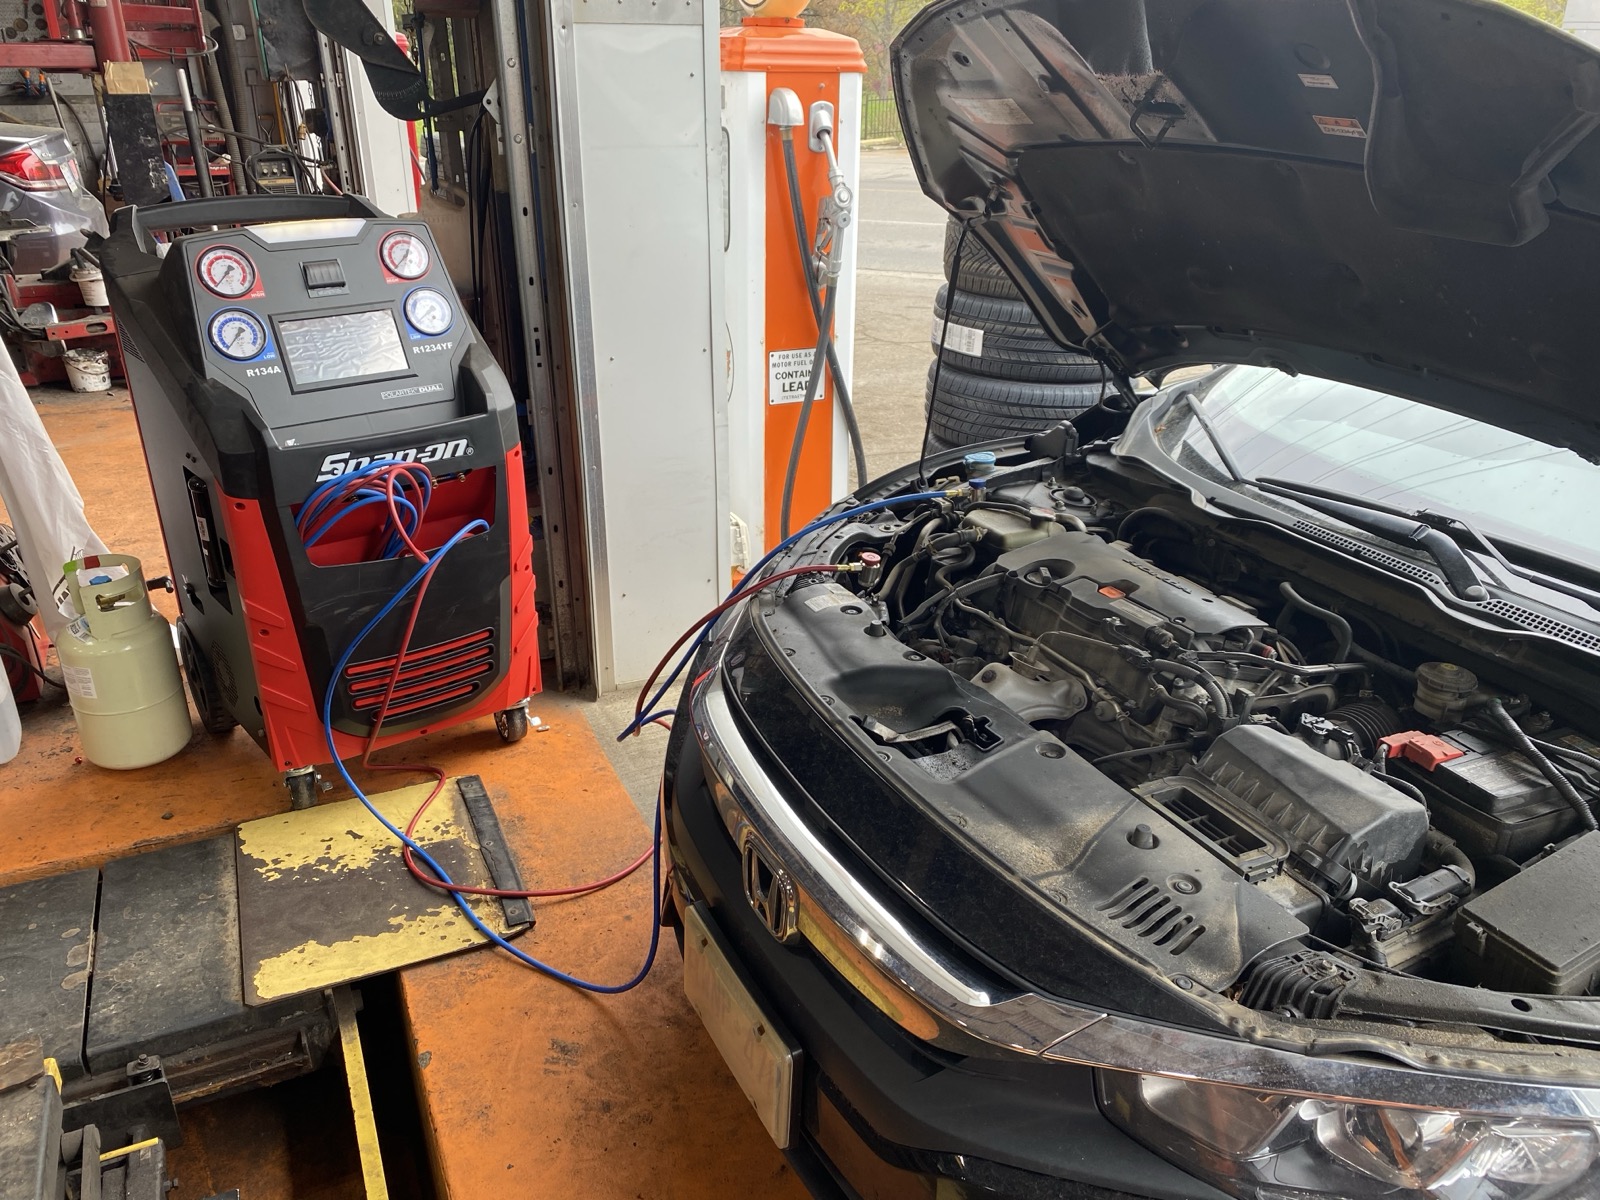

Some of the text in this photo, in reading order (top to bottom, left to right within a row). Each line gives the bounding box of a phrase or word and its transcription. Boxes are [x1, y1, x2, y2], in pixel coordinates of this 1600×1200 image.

[412, 341, 454, 354] R1234YF
[772, 361, 792, 369] MOTOR
[794, 359, 807, 367] FUEL
[246, 365, 282, 377] R134A
[419, 383, 443, 393] DUAL
